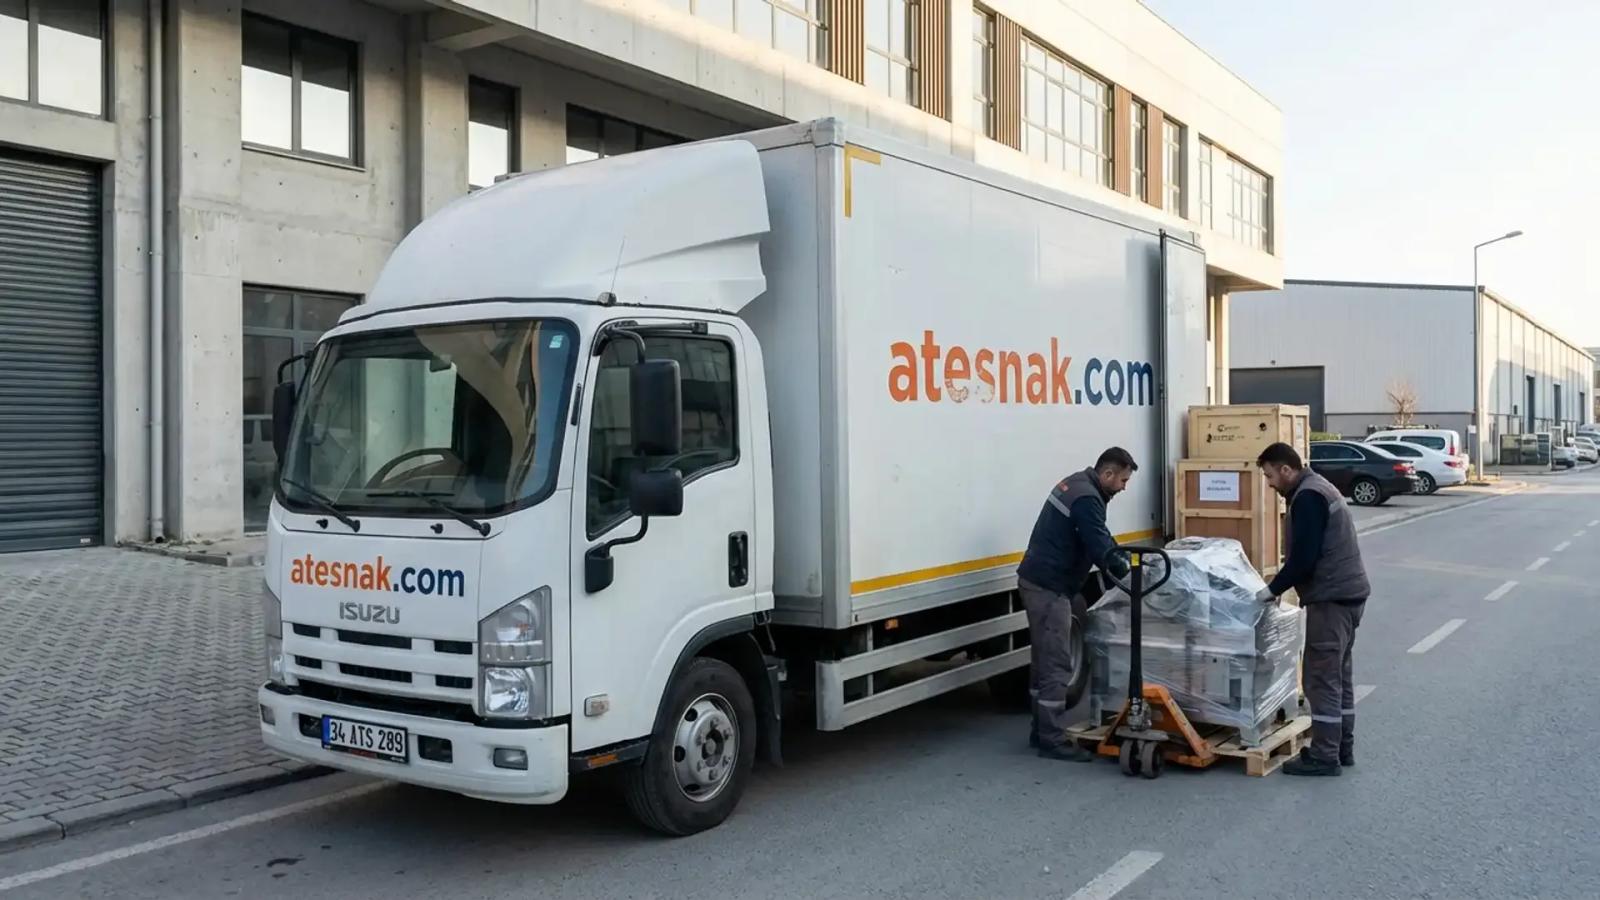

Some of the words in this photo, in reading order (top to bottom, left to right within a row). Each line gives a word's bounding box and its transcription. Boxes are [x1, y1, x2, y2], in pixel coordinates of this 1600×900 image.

[888, 330, 1153, 406] atesnak.com
[291, 554, 465, 597] atesnak.com
[339, 602, 400, 624] ISUZU
[330, 721, 346, 743] 34
[349, 724, 374, 749] ATS
[378, 729, 403, 753] 289
